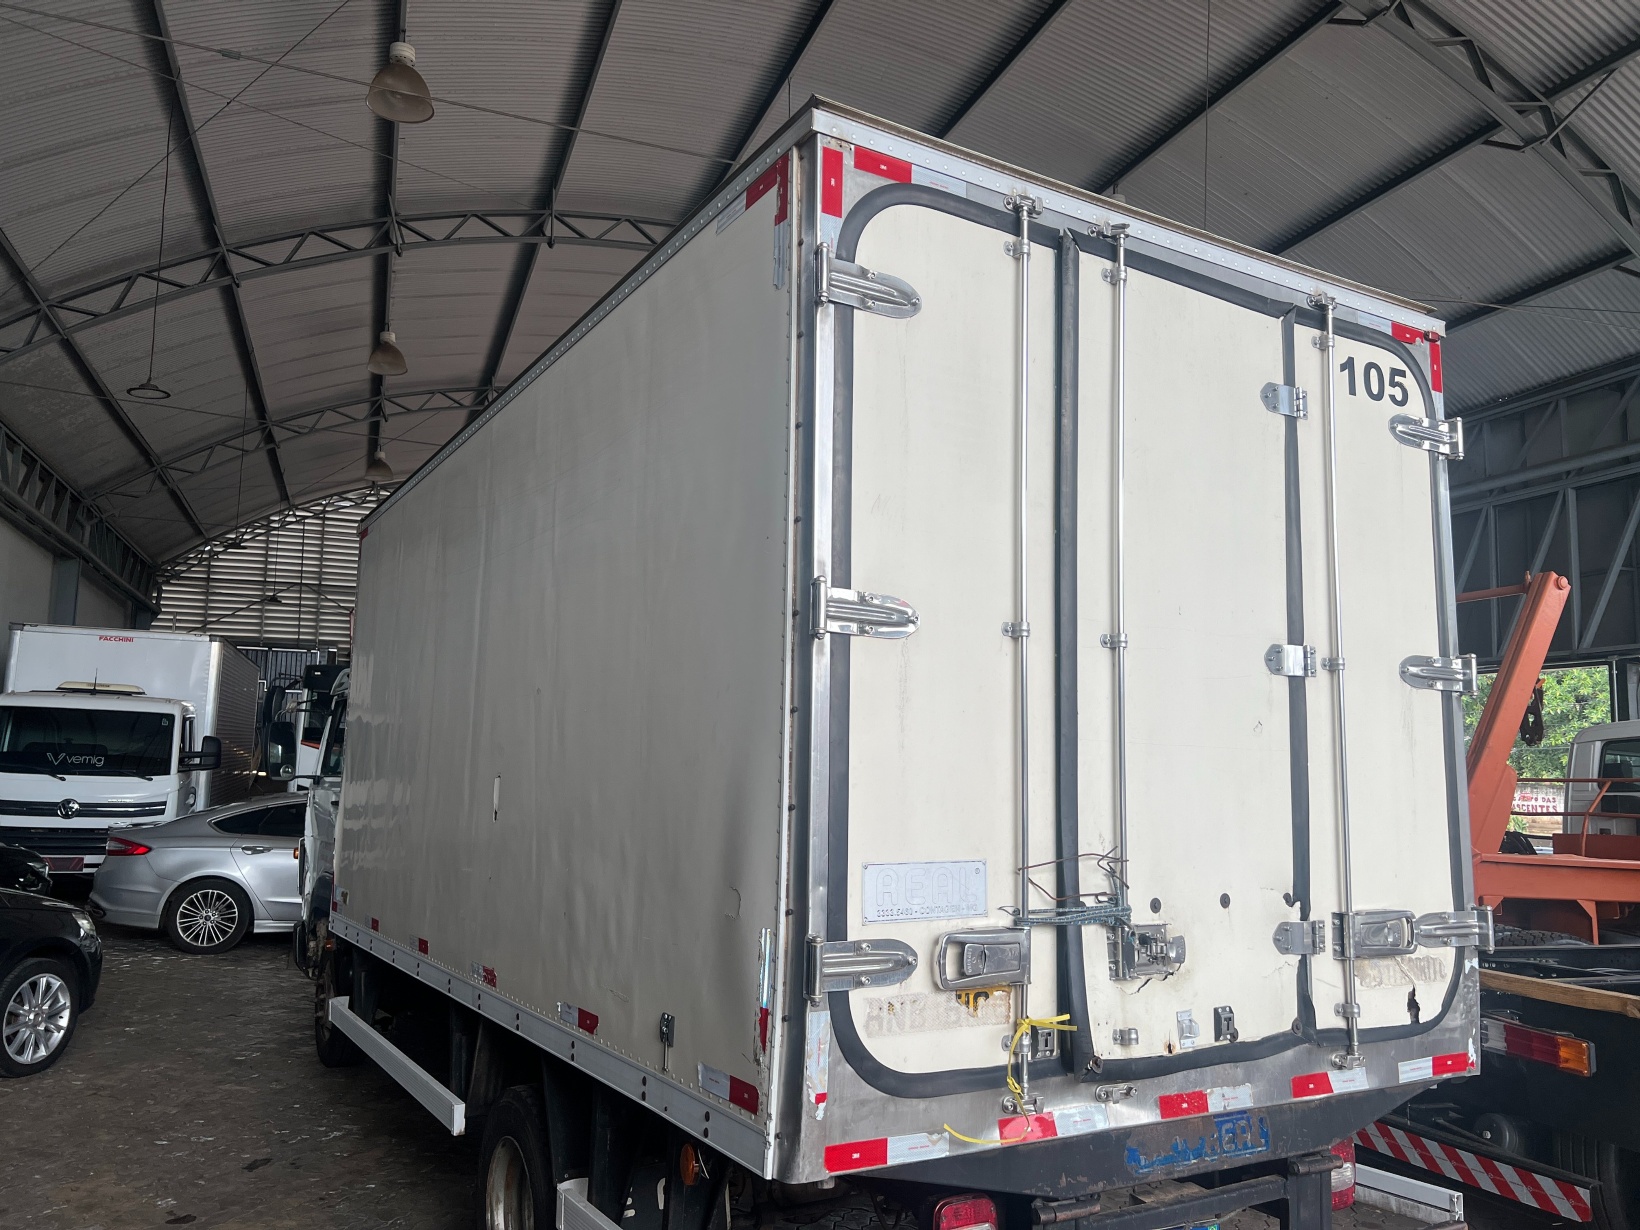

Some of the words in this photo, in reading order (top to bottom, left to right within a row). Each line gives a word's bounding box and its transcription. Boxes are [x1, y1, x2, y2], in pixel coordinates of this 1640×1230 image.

[1339, 355, 1409, 407] 105
[98, 635, 134, 643] FACCHINI
[66, 755, 105, 767] vemig
[875, 867, 978, 906] REAL
